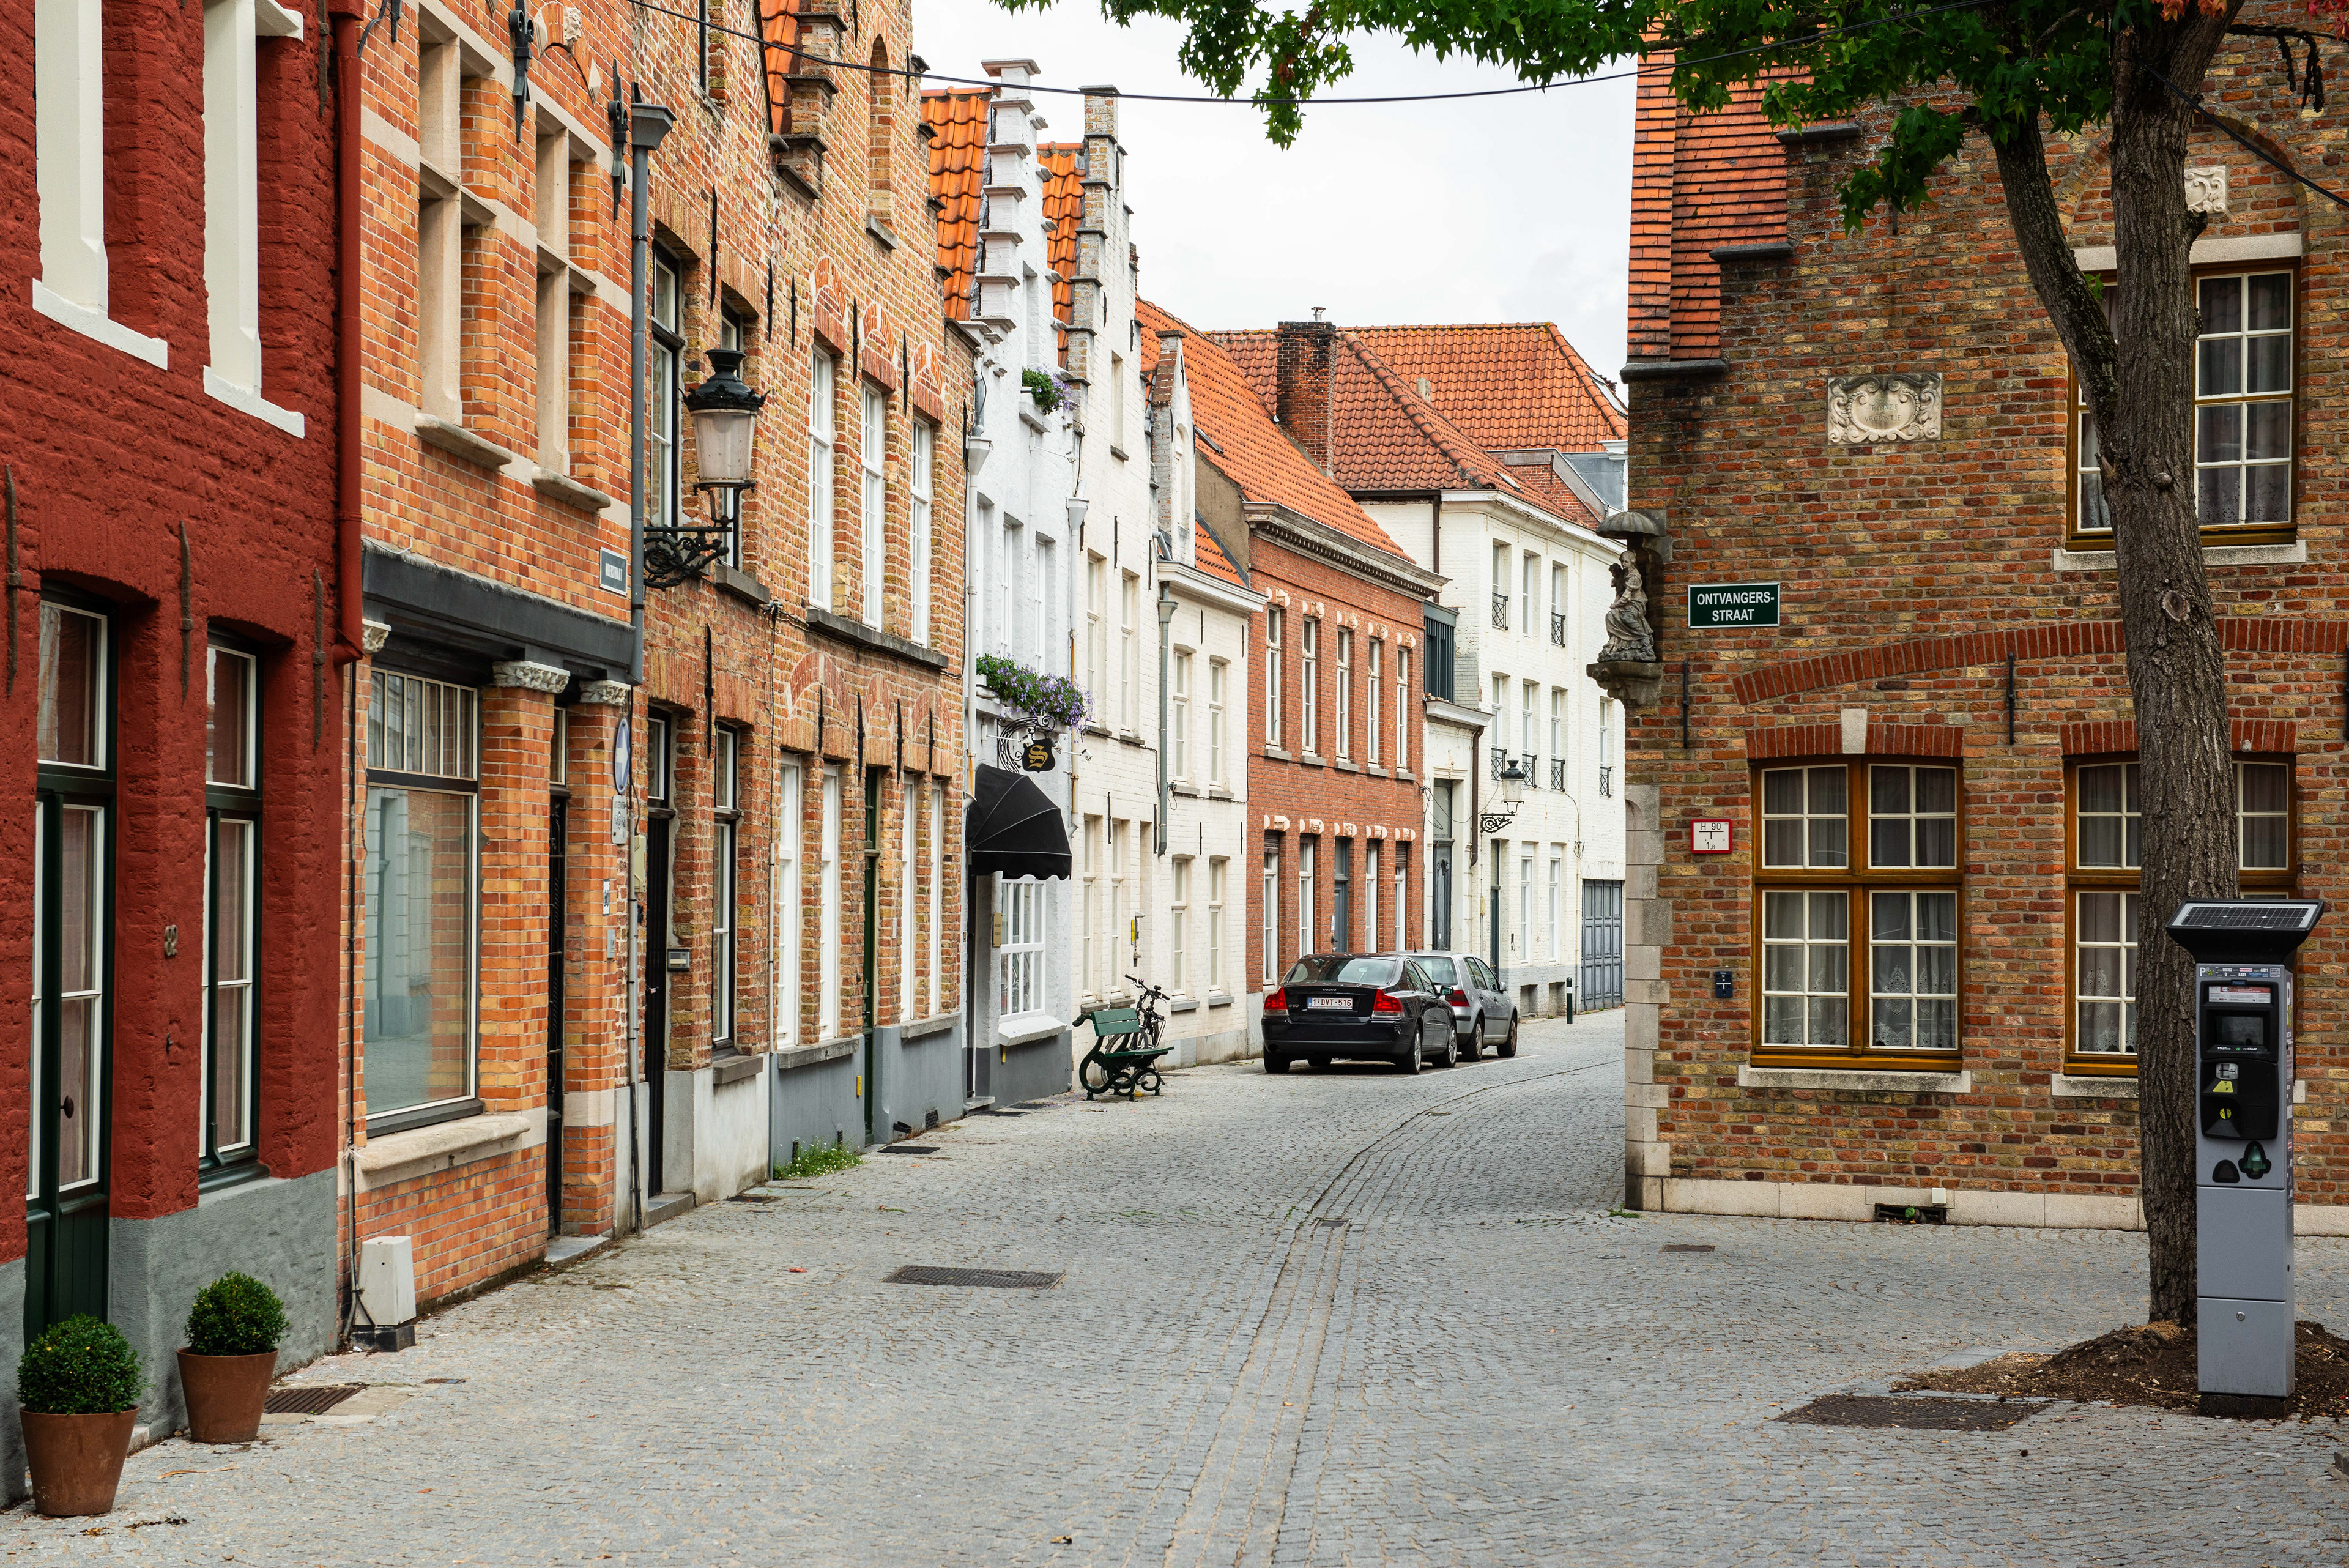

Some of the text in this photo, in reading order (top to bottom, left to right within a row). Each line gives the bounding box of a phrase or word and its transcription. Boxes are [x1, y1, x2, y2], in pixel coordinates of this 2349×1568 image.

[1697, 592, 1775, 605] ONTVANGERS-
[1712, 609, 1754, 622] STRAAT
[1028, 745, 1048, 768] S
[165, 924, 178, 956] 82
[2200, 967, 2206, 976] P
